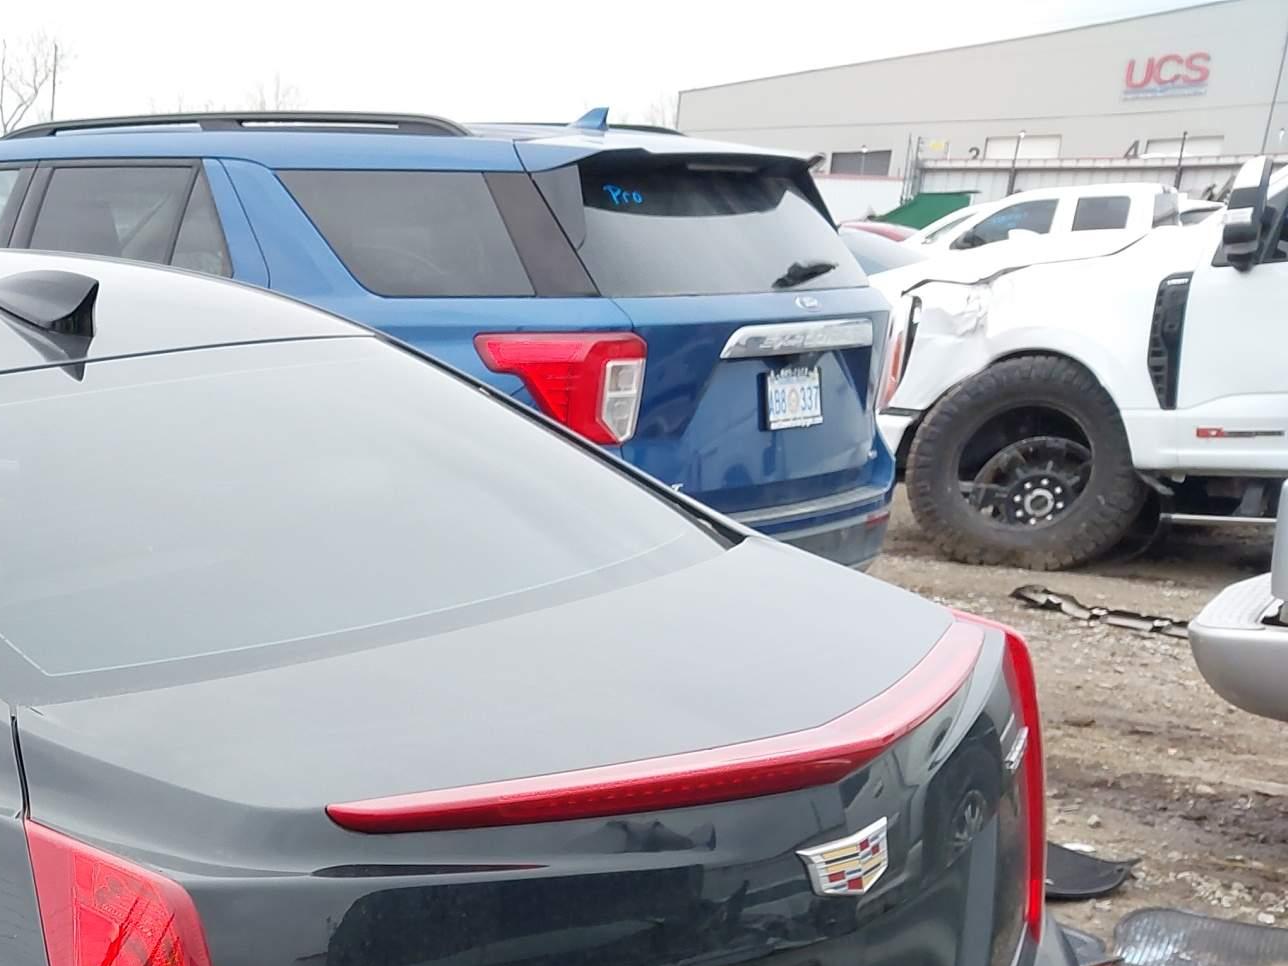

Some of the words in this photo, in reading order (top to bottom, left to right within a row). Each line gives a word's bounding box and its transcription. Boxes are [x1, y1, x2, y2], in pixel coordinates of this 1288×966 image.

[1125, 52, 1211, 88] UCS
[602, 184, 644, 206] Pro
[799, 385, 819, 411] 337
